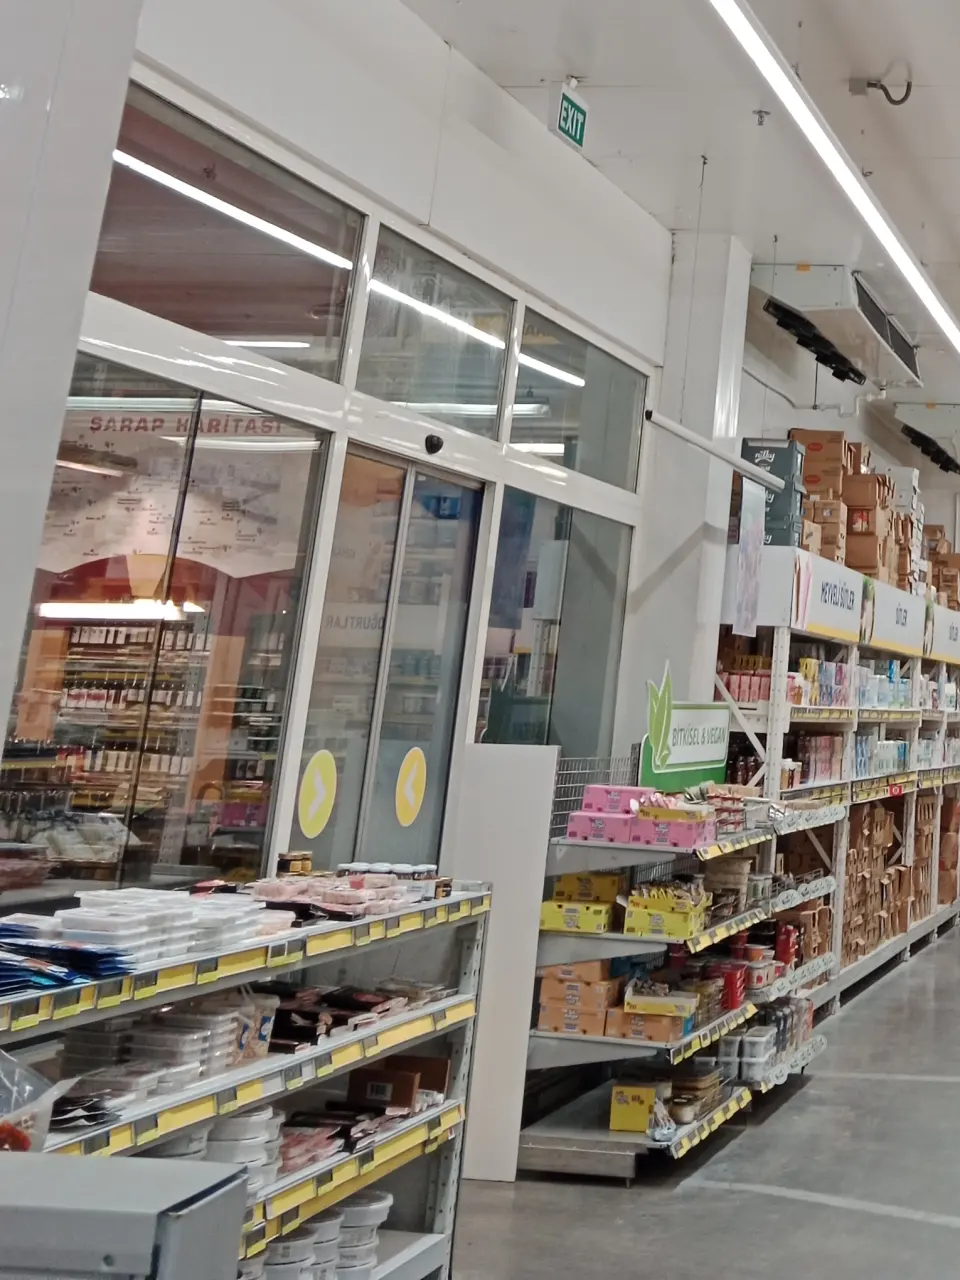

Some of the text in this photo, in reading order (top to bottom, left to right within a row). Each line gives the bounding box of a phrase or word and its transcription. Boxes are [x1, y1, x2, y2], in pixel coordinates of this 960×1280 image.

[560, 100, 585, 140] EXIT
[89, 415, 165, 434] ŞARAP
[706, 727, 727, 745] VEGAN
